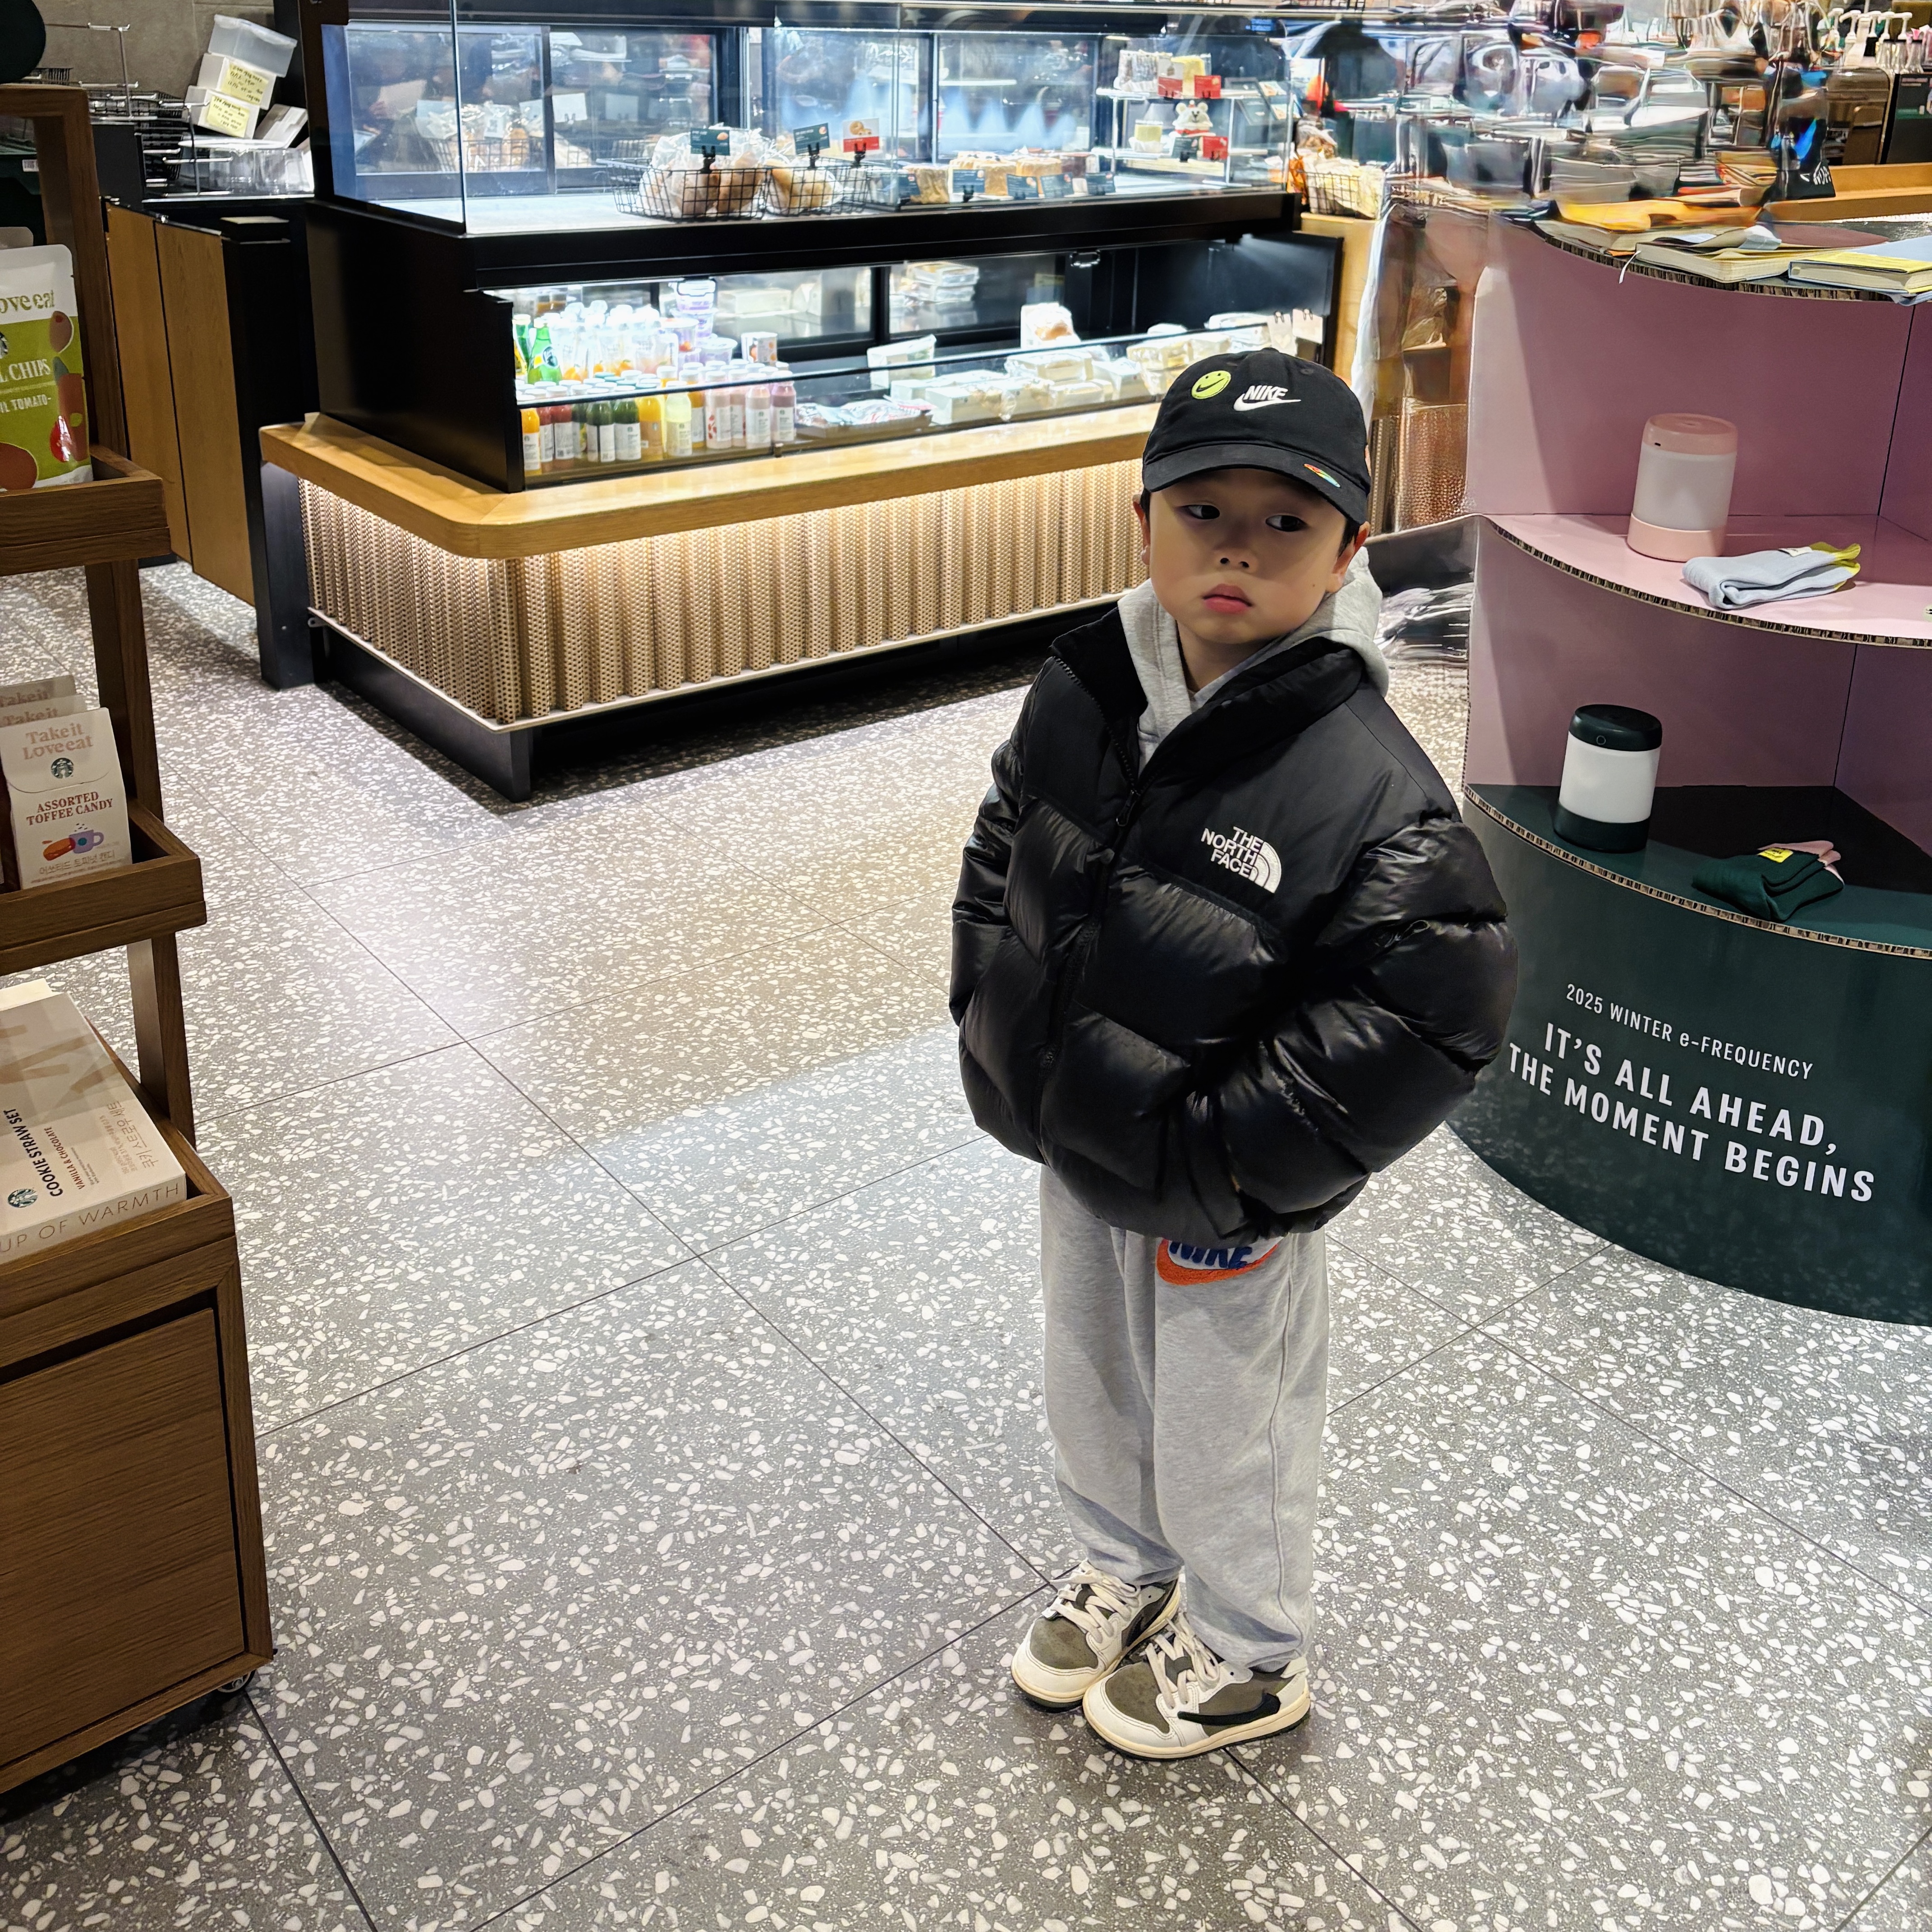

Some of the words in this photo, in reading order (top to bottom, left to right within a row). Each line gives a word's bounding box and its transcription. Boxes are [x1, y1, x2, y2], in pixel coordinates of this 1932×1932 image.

[9, 359, 51, 381] CHIPS
[1243, 385, 1289, 400] NIKE
[2, 712, 45, 727] Take
[25, 727, 69, 744] Take
[69, 723, 85, 736] it
[23, 743, 64, 760] Love
[65, 736, 93, 751] eat
[26, 808, 74, 826] TOFFEE
[75, 798, 113, 814] CANDY
[37, 791, 99, 813] ASSORTED
[1201, 828, 1258, 865] NORTH
[1232, 826, 1264, 852] THE
[1211, 848, 1254, 878] FACE
[1566, 984, 1603, 1014] 2025
[1610, 1002, 1673, 1042] WINTER
[1679, 1032, 1813, 1080] e-FREQUENCY
[1545, 1022, 1602, 1075] IT'S
[1614, 1059, 1673, 1106] ALL
[1689, 1086, 1837, 1155] AHEAD,
[3, 1109, 22, 1124] SET
[107, 1101, 125, 1117] 세트
[1509, 1042, 1554, 1095] THE
[1564, 1077, 1709, 1161] MOMENT
[1724, 1141, 1875, 1202] BEGINS
[12, 1125, 42, 1158] STRAW
[44, 1126, 68, 1159] CHOCOLATE
[117, 1118, 148, 1148] 스트로우
[136, 1149, 159, 1168] 쿠키
[32, 1158, 63, 1197] COOKIE
[66, 1164, 85, 1190] VANILLA
[39, 1219, 68, 1239] OF
[78, 1183, 178, 1225] WARMTH
